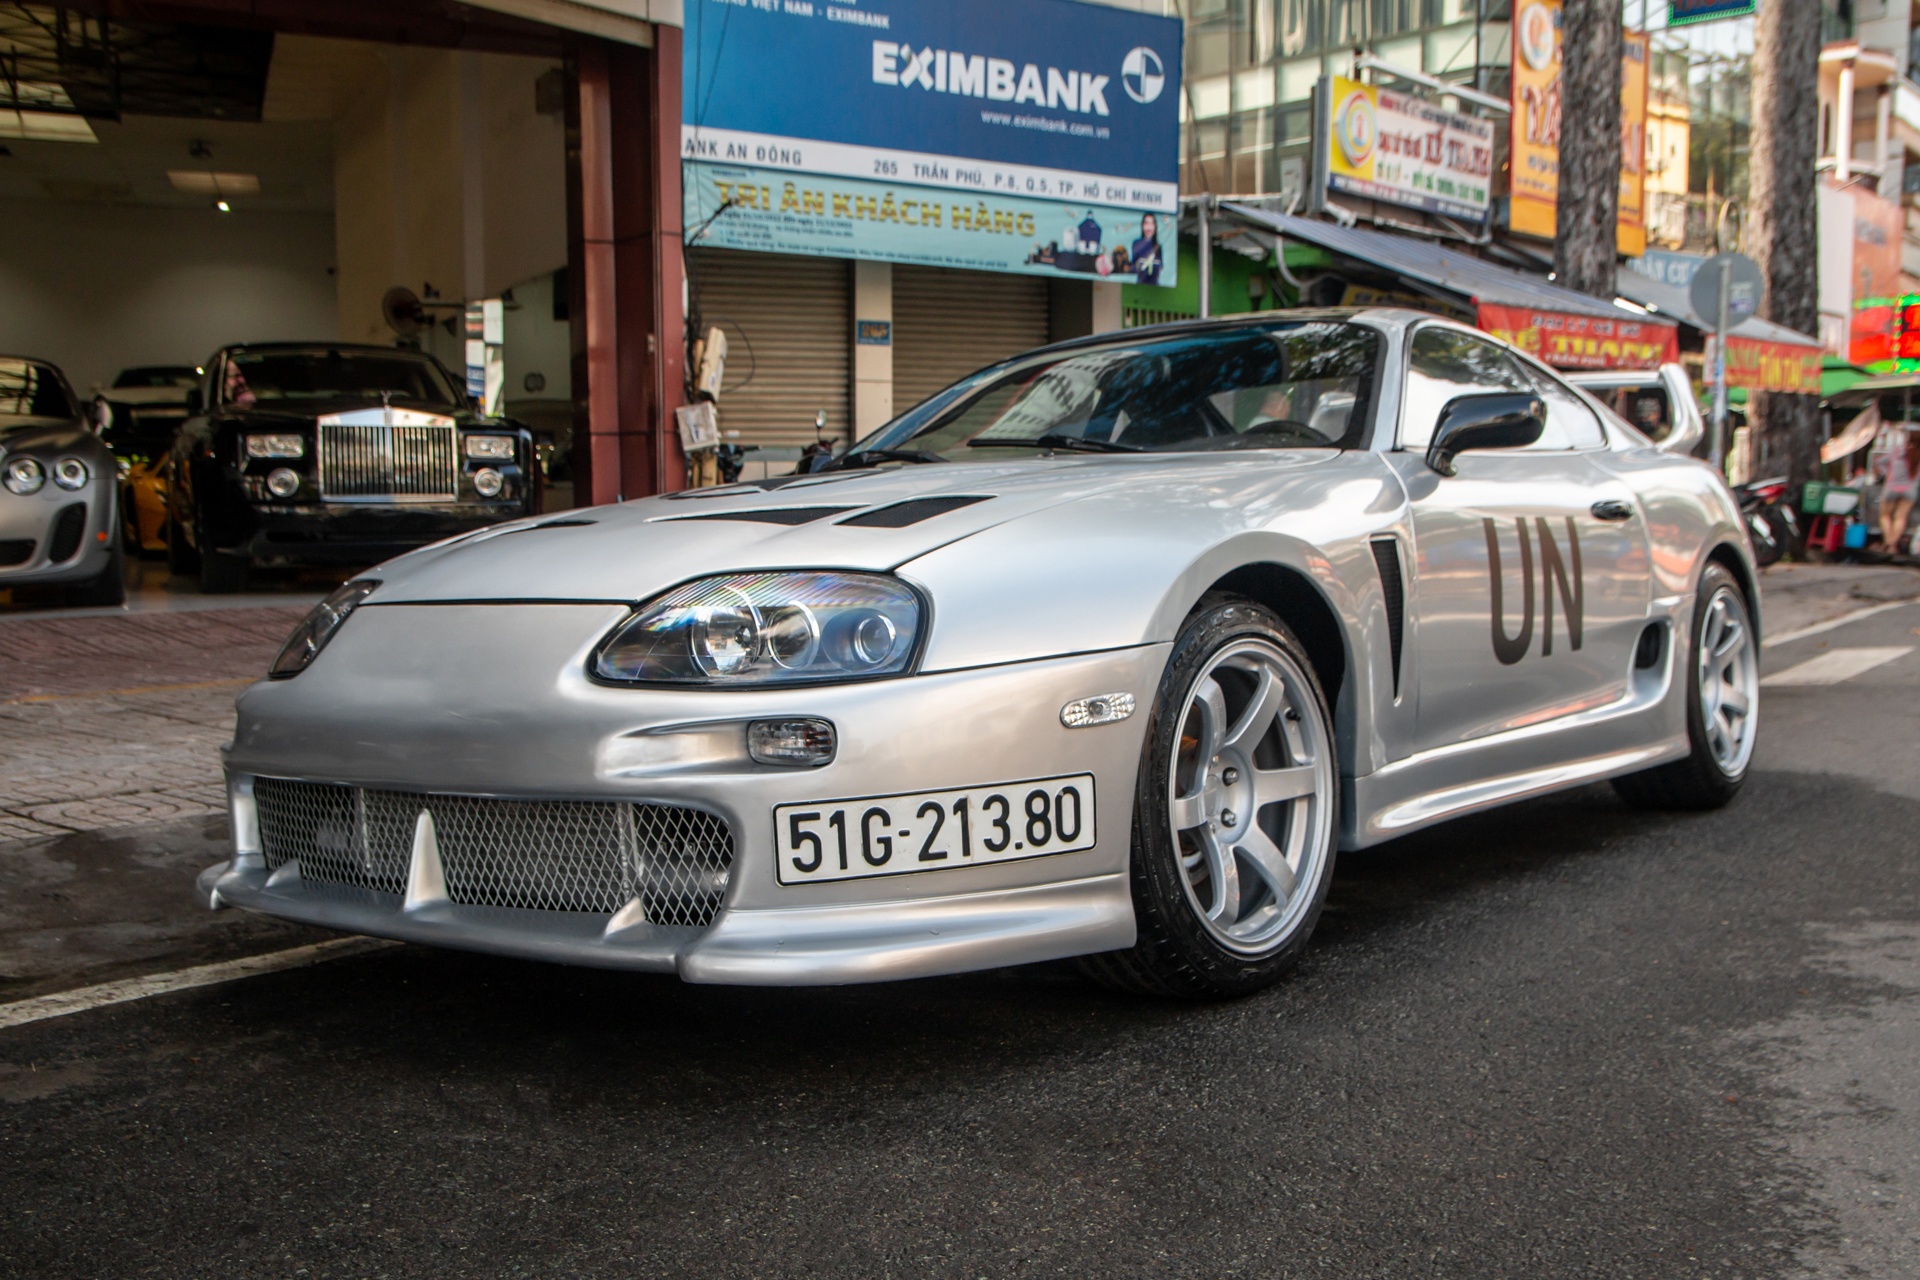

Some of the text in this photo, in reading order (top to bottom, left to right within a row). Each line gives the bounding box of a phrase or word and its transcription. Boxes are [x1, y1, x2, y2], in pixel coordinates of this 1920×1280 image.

[784, 0, 813, 17] NAM
[827, 6, 890, 29] EXIMBANK
[872, 40, 1110, 116] EXIMBANK
[980, 110, 1110, 140] www.eximbank.com.vn
[726, 143, 748, 160] AN
[756, 143, 803, 166] ĐÔNG
[873, 158, 898, 176] 265
[1131, 188, 1163, 205] MINH
[714, 180, 770, 212] TRI
[779, 180, 824, 216] ÂN
[832, 191, 942, 228] KHÁCH
[951, 200, 1035, 236] HÀNG
[1482, 516, 1584, 666] UN
[789, 785, 1082, 873] 51G-213.80
